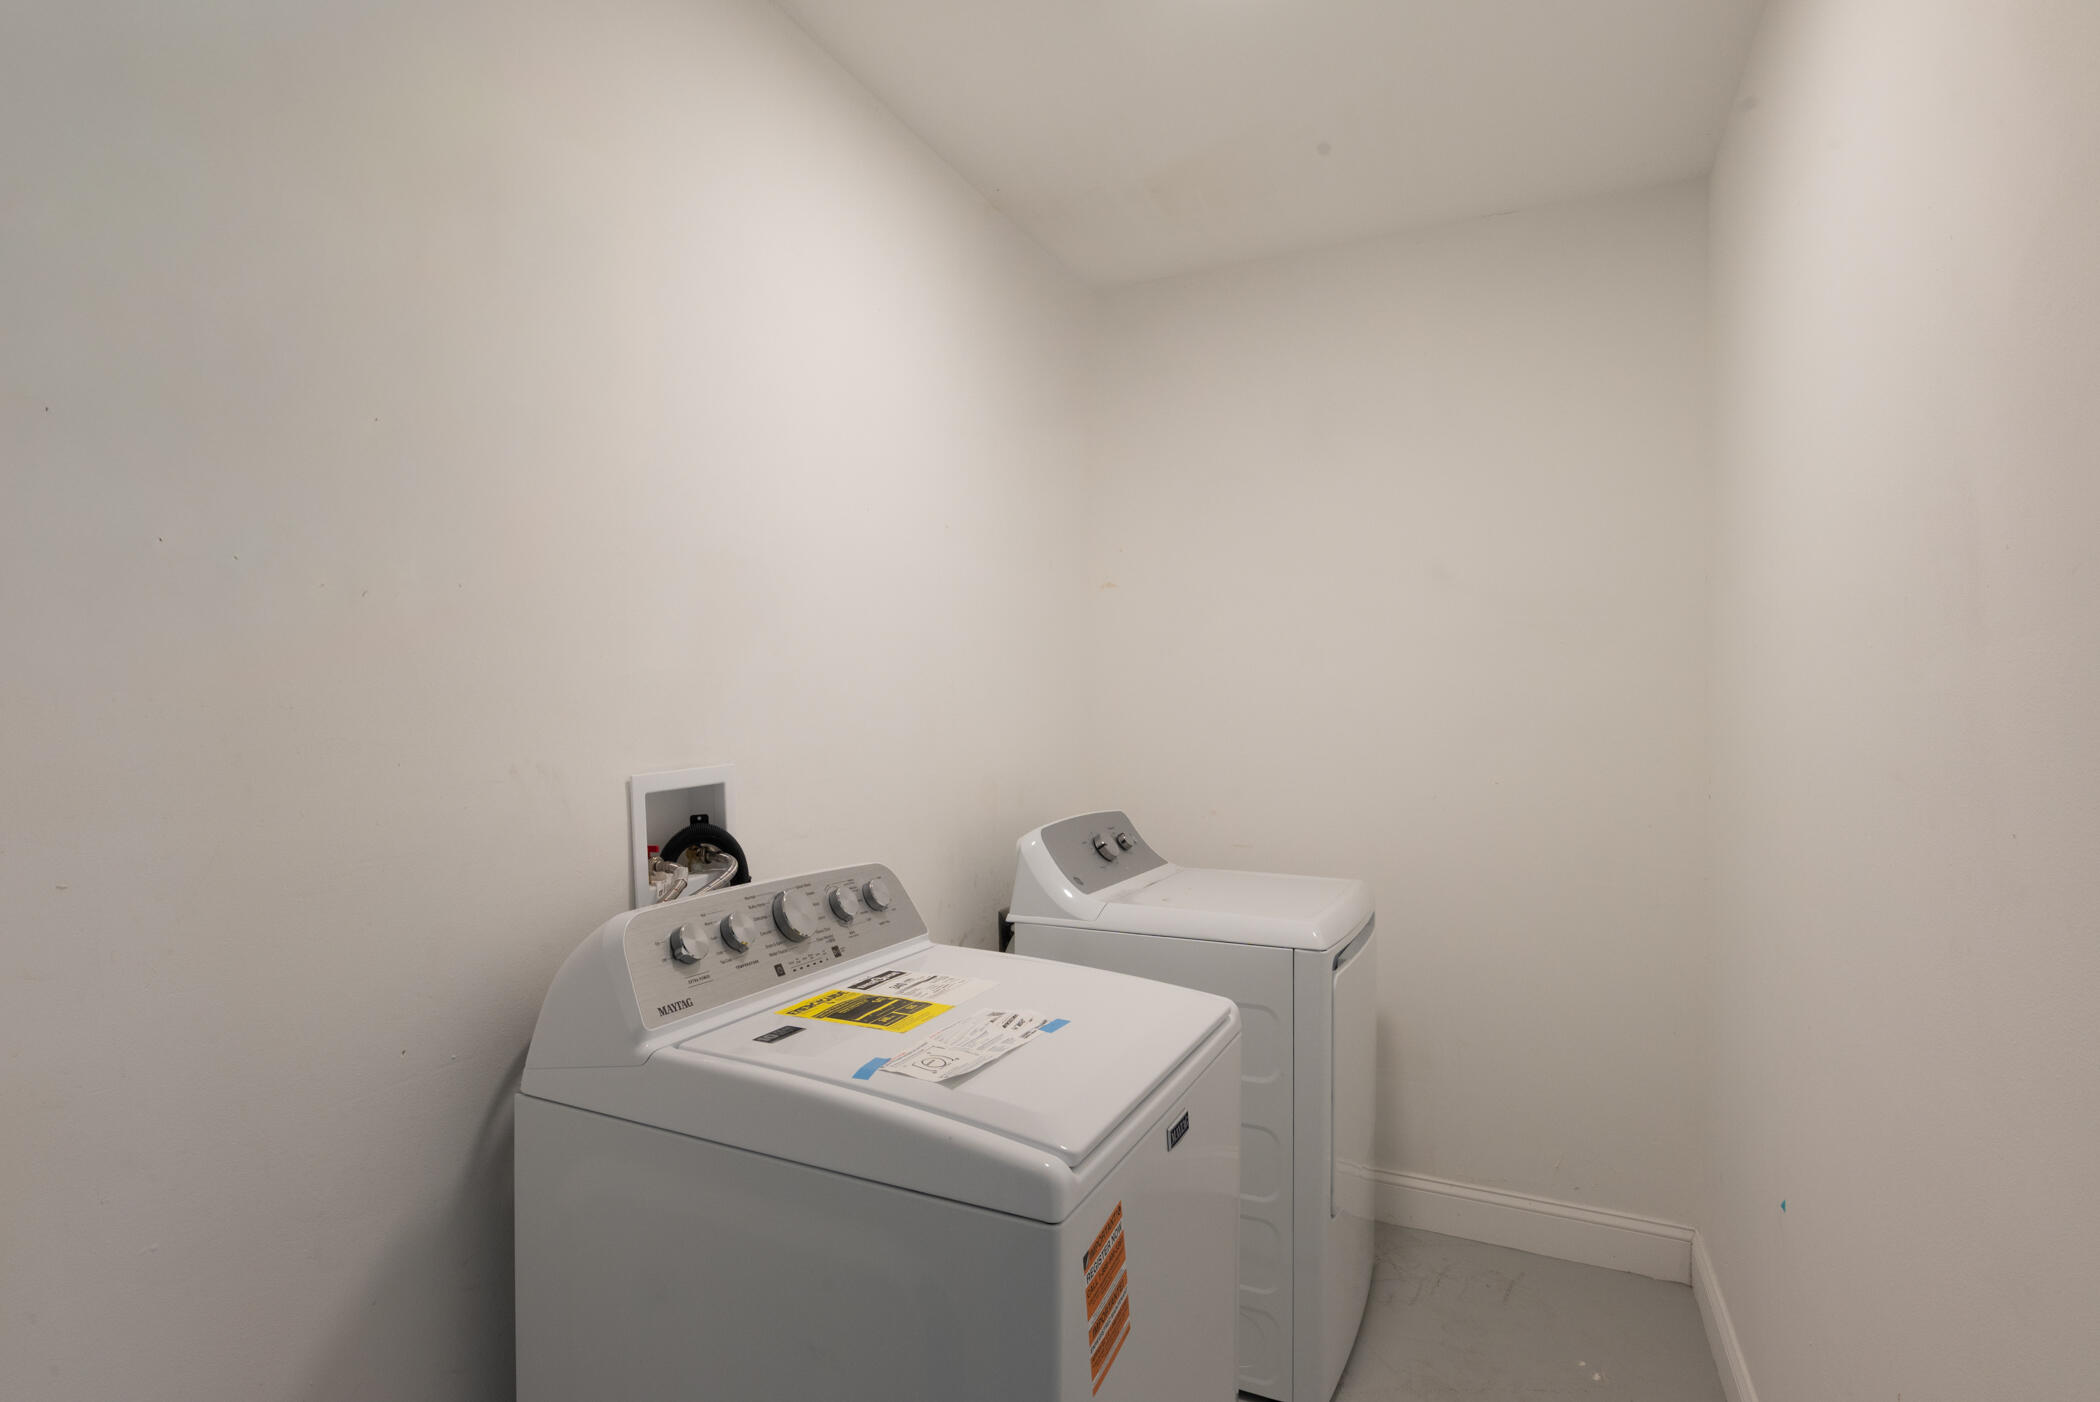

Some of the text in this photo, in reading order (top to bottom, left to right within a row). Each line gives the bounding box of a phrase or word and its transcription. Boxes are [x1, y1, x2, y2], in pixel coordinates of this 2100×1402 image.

[657, 998, 694, 1016] MAYTAG
[1086, 1240, 1111, 1285] REGISTER
[1111, 1221, 1122, 1243] NOW
